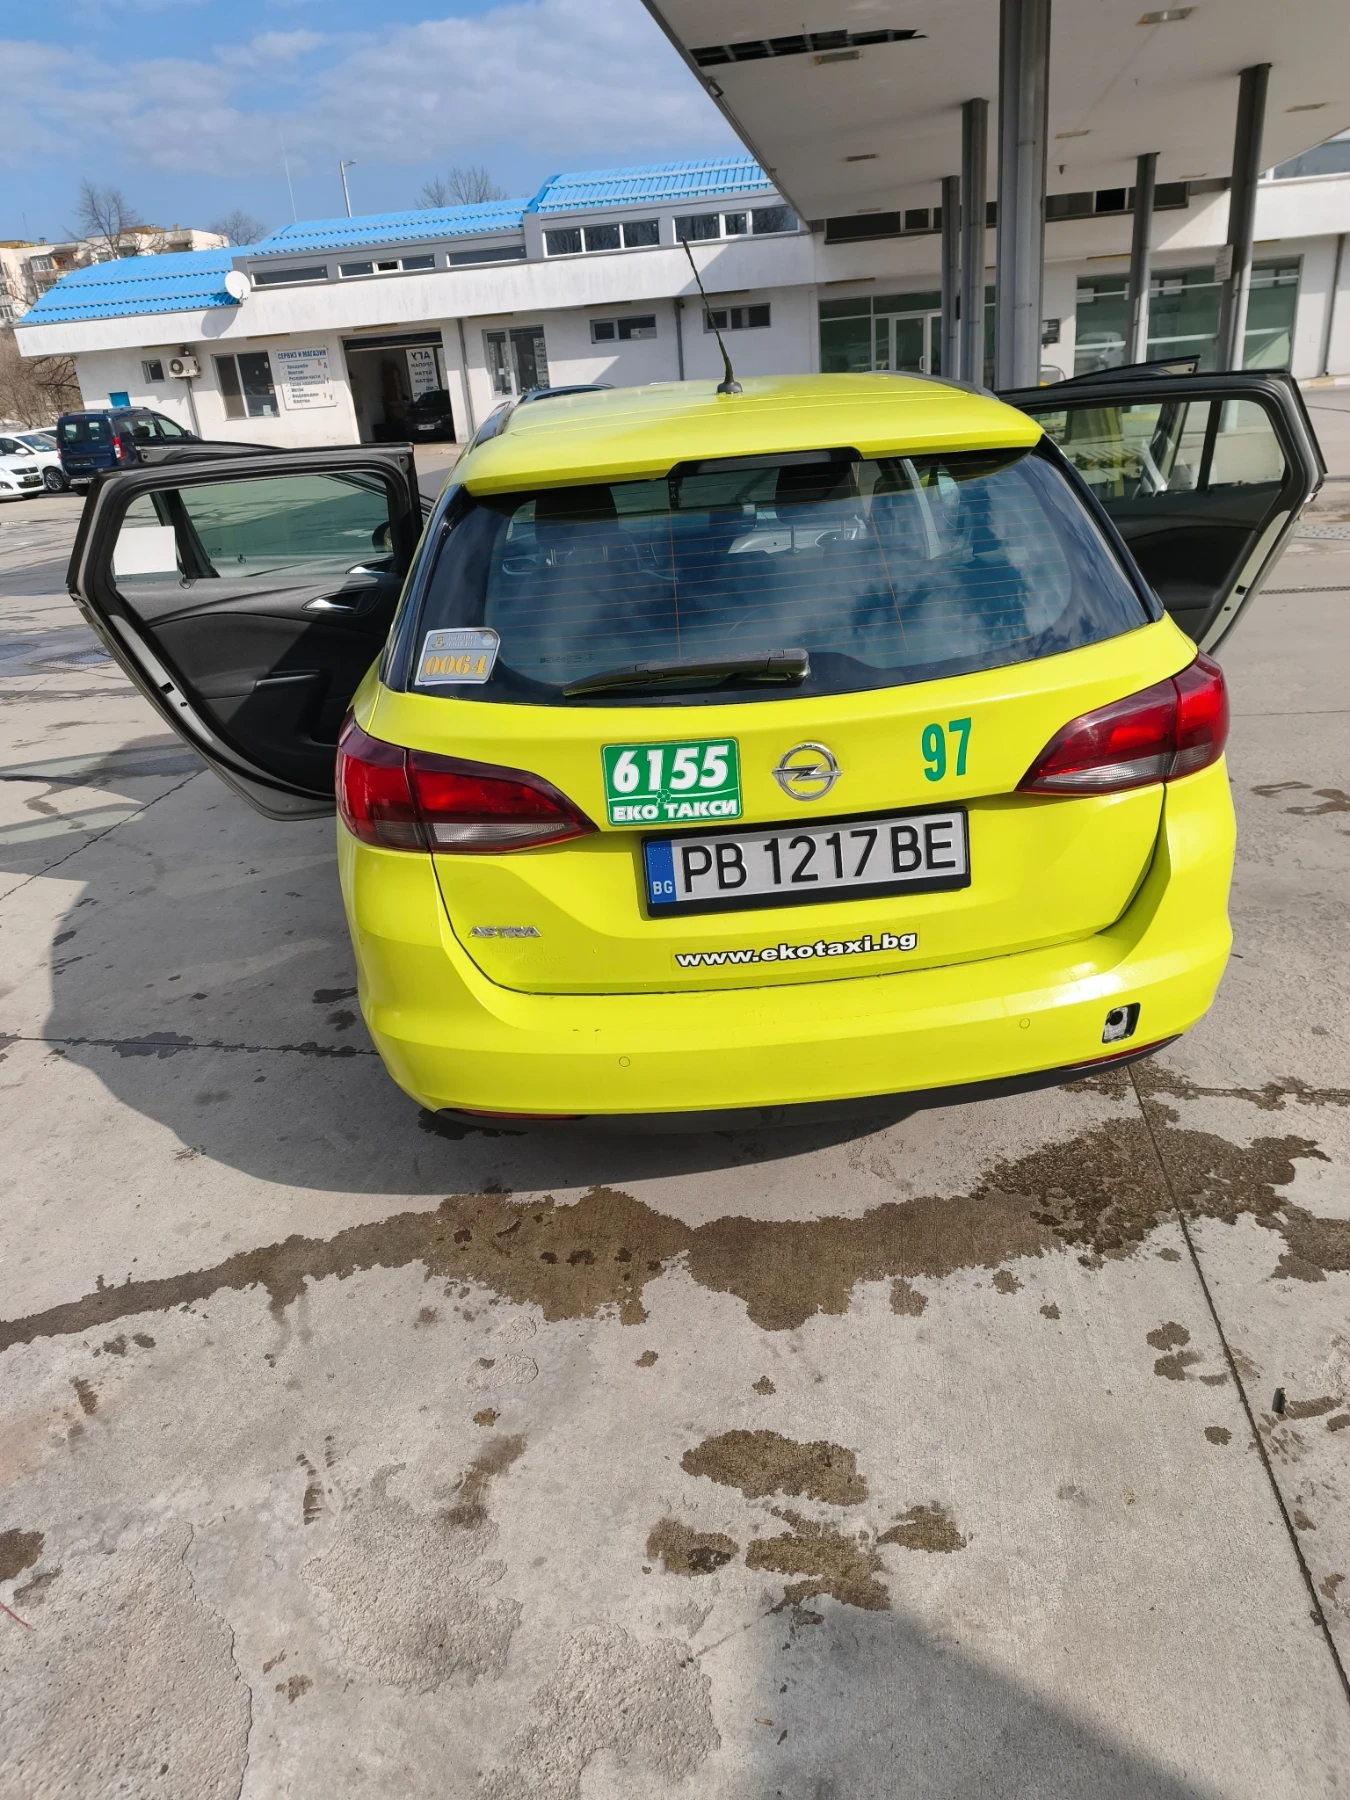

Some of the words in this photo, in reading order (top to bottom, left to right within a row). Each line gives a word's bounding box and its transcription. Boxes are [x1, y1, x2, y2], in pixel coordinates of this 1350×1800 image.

[277, 351, 298, 360] СЕРВИЗ
[298, 350, 302, 358] И
[302, 349, 327, 358] МАГАЗИН
[425, 655, 488, 676] 0064
[921, 717, 972, 782] 97
[612, 745, 729, 793] 6155
[612, 804, 659, 821] ЕКО
[663, 799, 738, 819] ТАКСИ
[681, 842, 747, 893] PB
[763, 828, 878, 885] 1217
[890, 821, 957, 874] BE
[652, 881, 674, 896] BG
[468, 926, 542, 938] ASTRA
[675, 932, 917, 968] www.ekotaxi.bg
